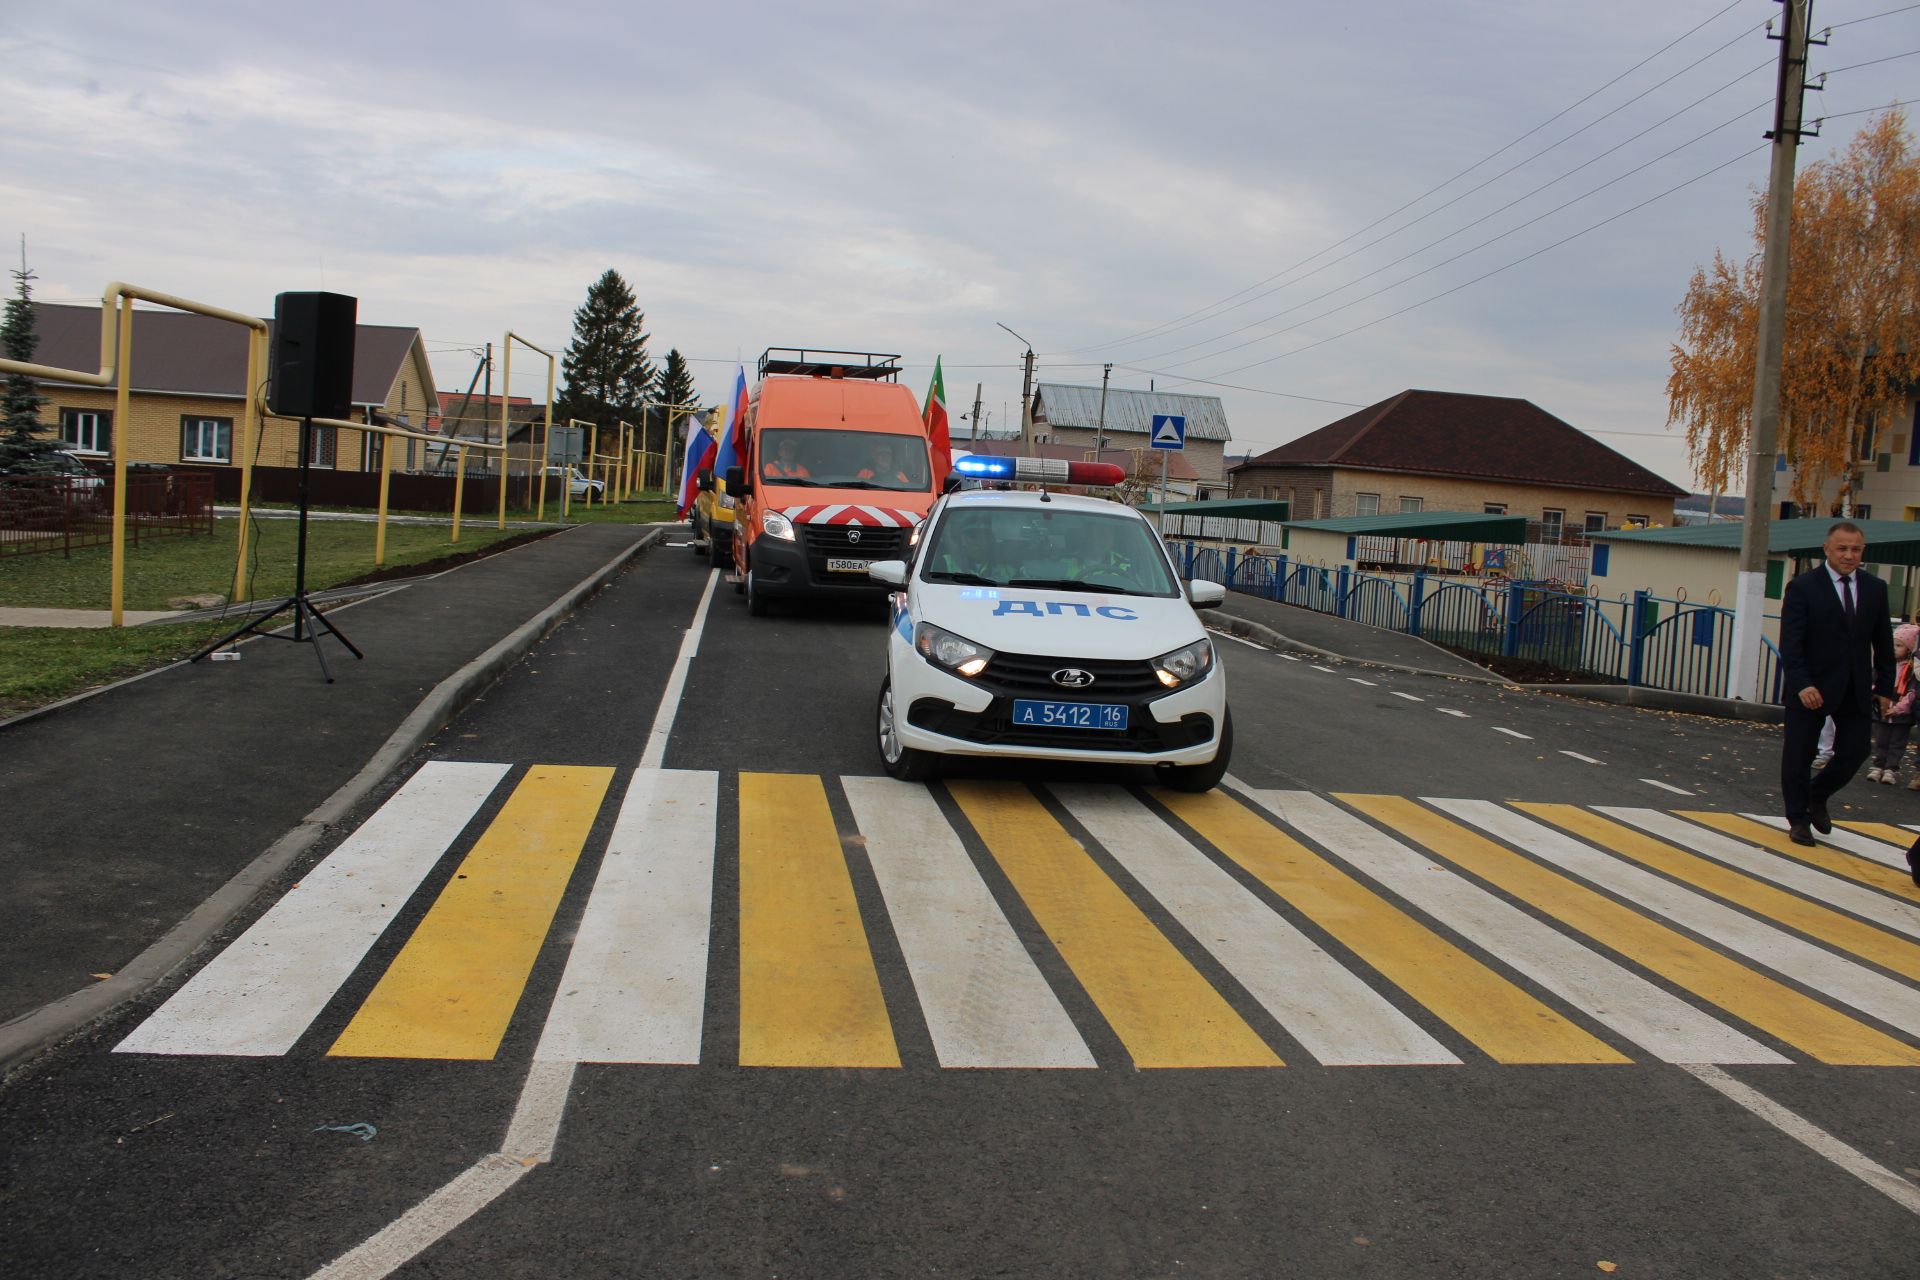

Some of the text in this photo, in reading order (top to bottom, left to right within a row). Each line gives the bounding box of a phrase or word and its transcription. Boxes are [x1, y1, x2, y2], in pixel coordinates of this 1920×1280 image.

[992, 600, 1139, 621] ДПС
[1023, 704, 1121, 725] А 5412 16
